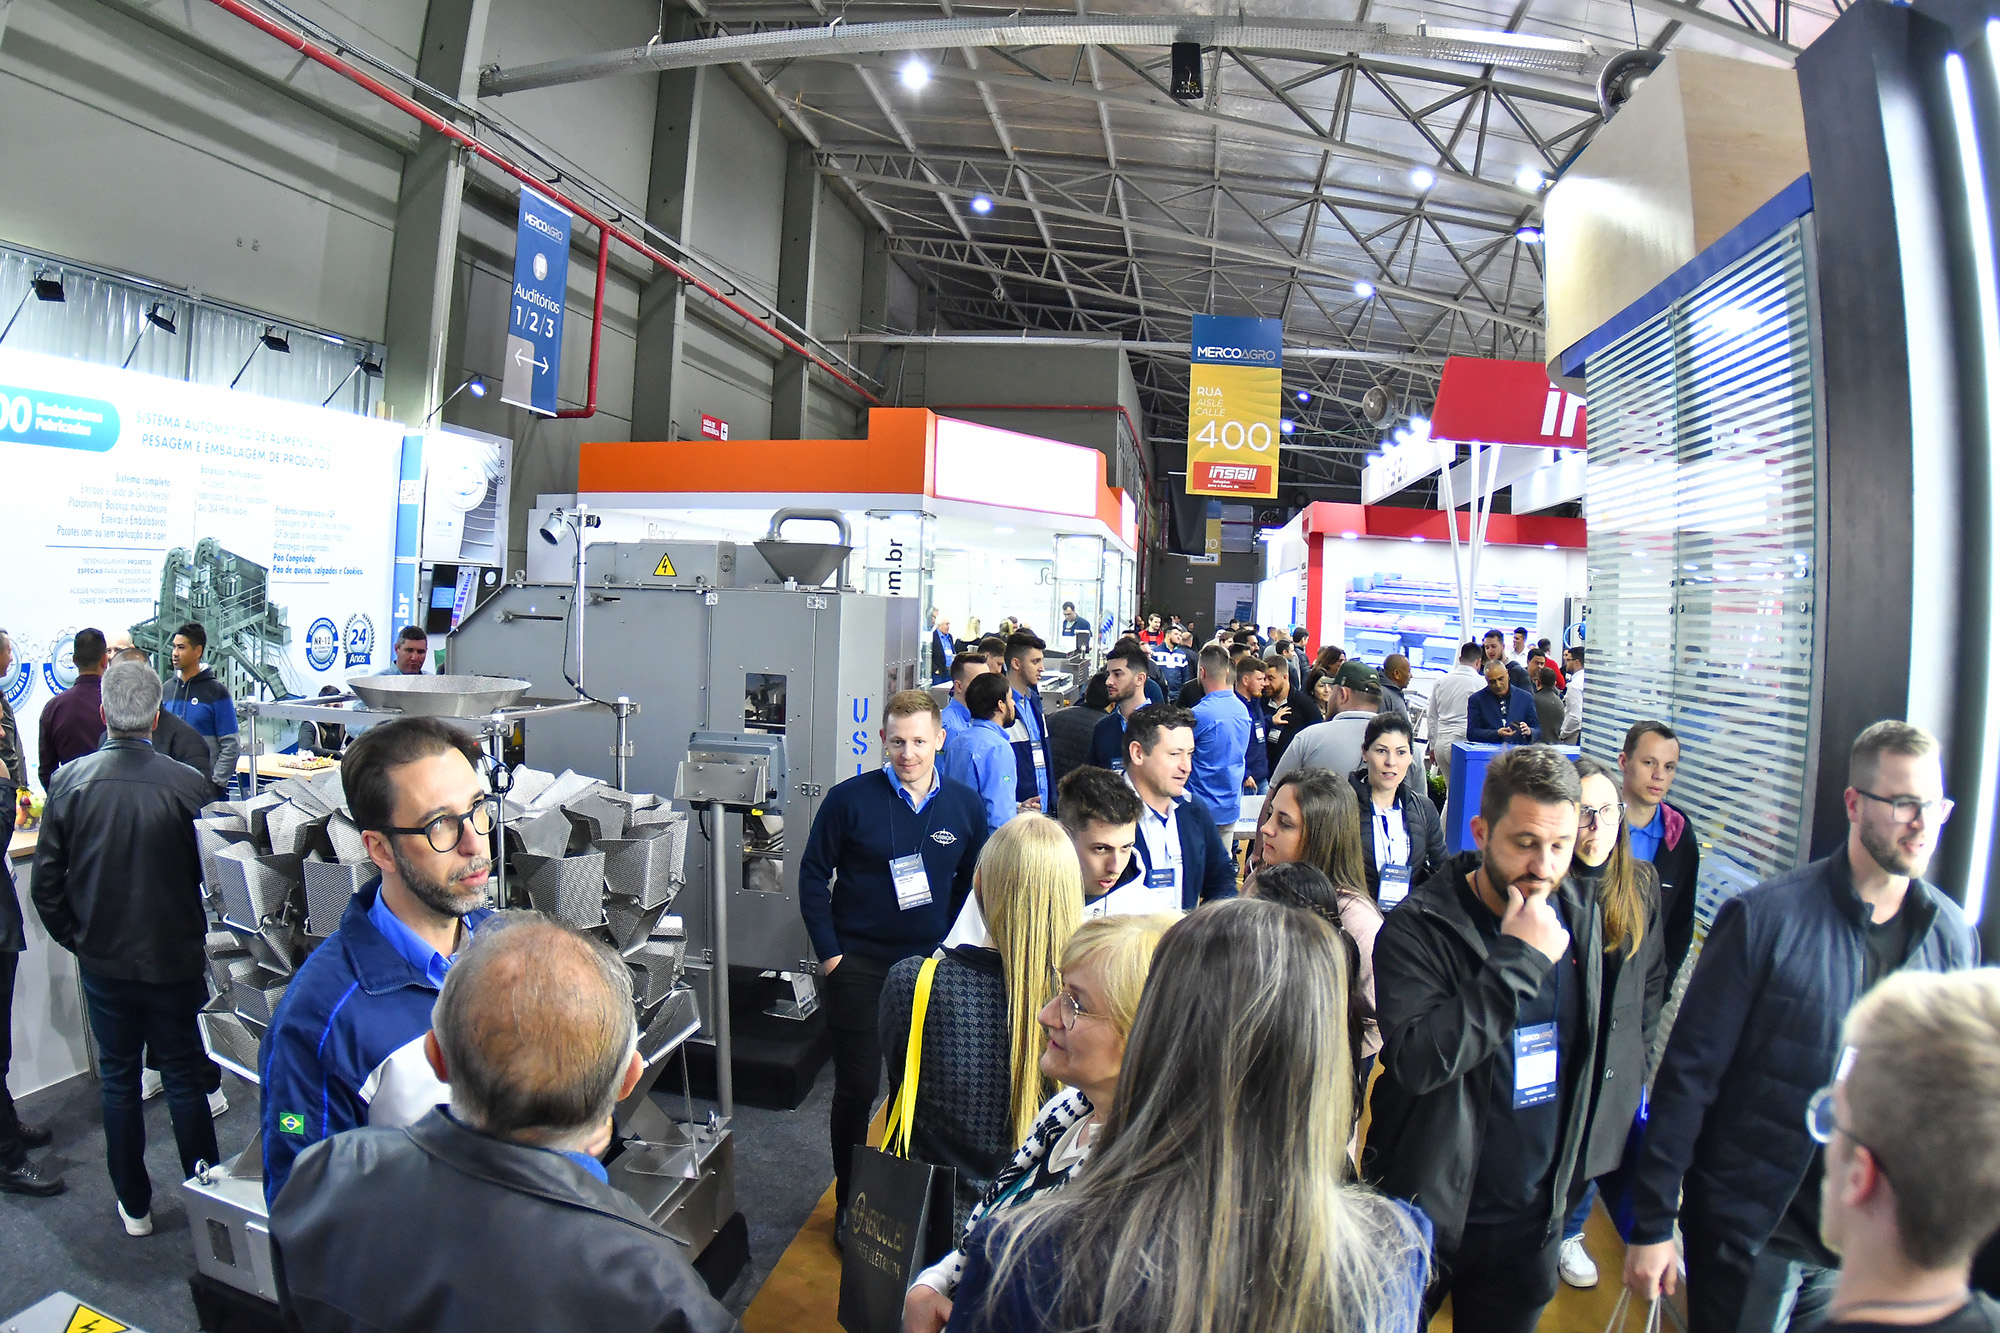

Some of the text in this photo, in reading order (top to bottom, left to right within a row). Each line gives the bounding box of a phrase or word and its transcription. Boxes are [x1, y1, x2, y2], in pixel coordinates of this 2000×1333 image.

[524, 211, 563, 241] MERCOAGRO
[514, 283, 560, 315] Auditórios
[516, 305, 554, 338] 1/2/3
[1197, 345, 1276, 361] MERCOAGRO
[1197, 386, 1223, 397] RUA
[1196, 399, 1224, 408] AISLE
[136, 411, 180, 429] SISTEMA
[1195, 407, 1226, 417] CALLE
[1196, 420, 1272, 452] 400
[141, 433, 331, 470] PESAGEM E EMBALAGEM DE PRODUTOS
[115, 472, 171, 487] Sistema completo
[1208, 465, 1258, 481] install
[56, 524, 80, 537] Pacotes
[81, 528, 94, 537] com
[94, 529, 103, 538] ou
[103, 529, 116, 538] sem
[117, 528, 144, 541] aplicação
[144, 530, 152, 540] de
[272, 553, 285, 562] Pão
[272, 564, 284, 574] Pão
[285, 565, 292, 574] de
[314, 565, 338, 577] salgados
[885, 538, 903, 595] m.br
[394, 593, 410, 632] .br
[314, 636, 331, 645] NR-12
[350, 628, 367, 646] 24
[349, 653, 366, 664] Anos
